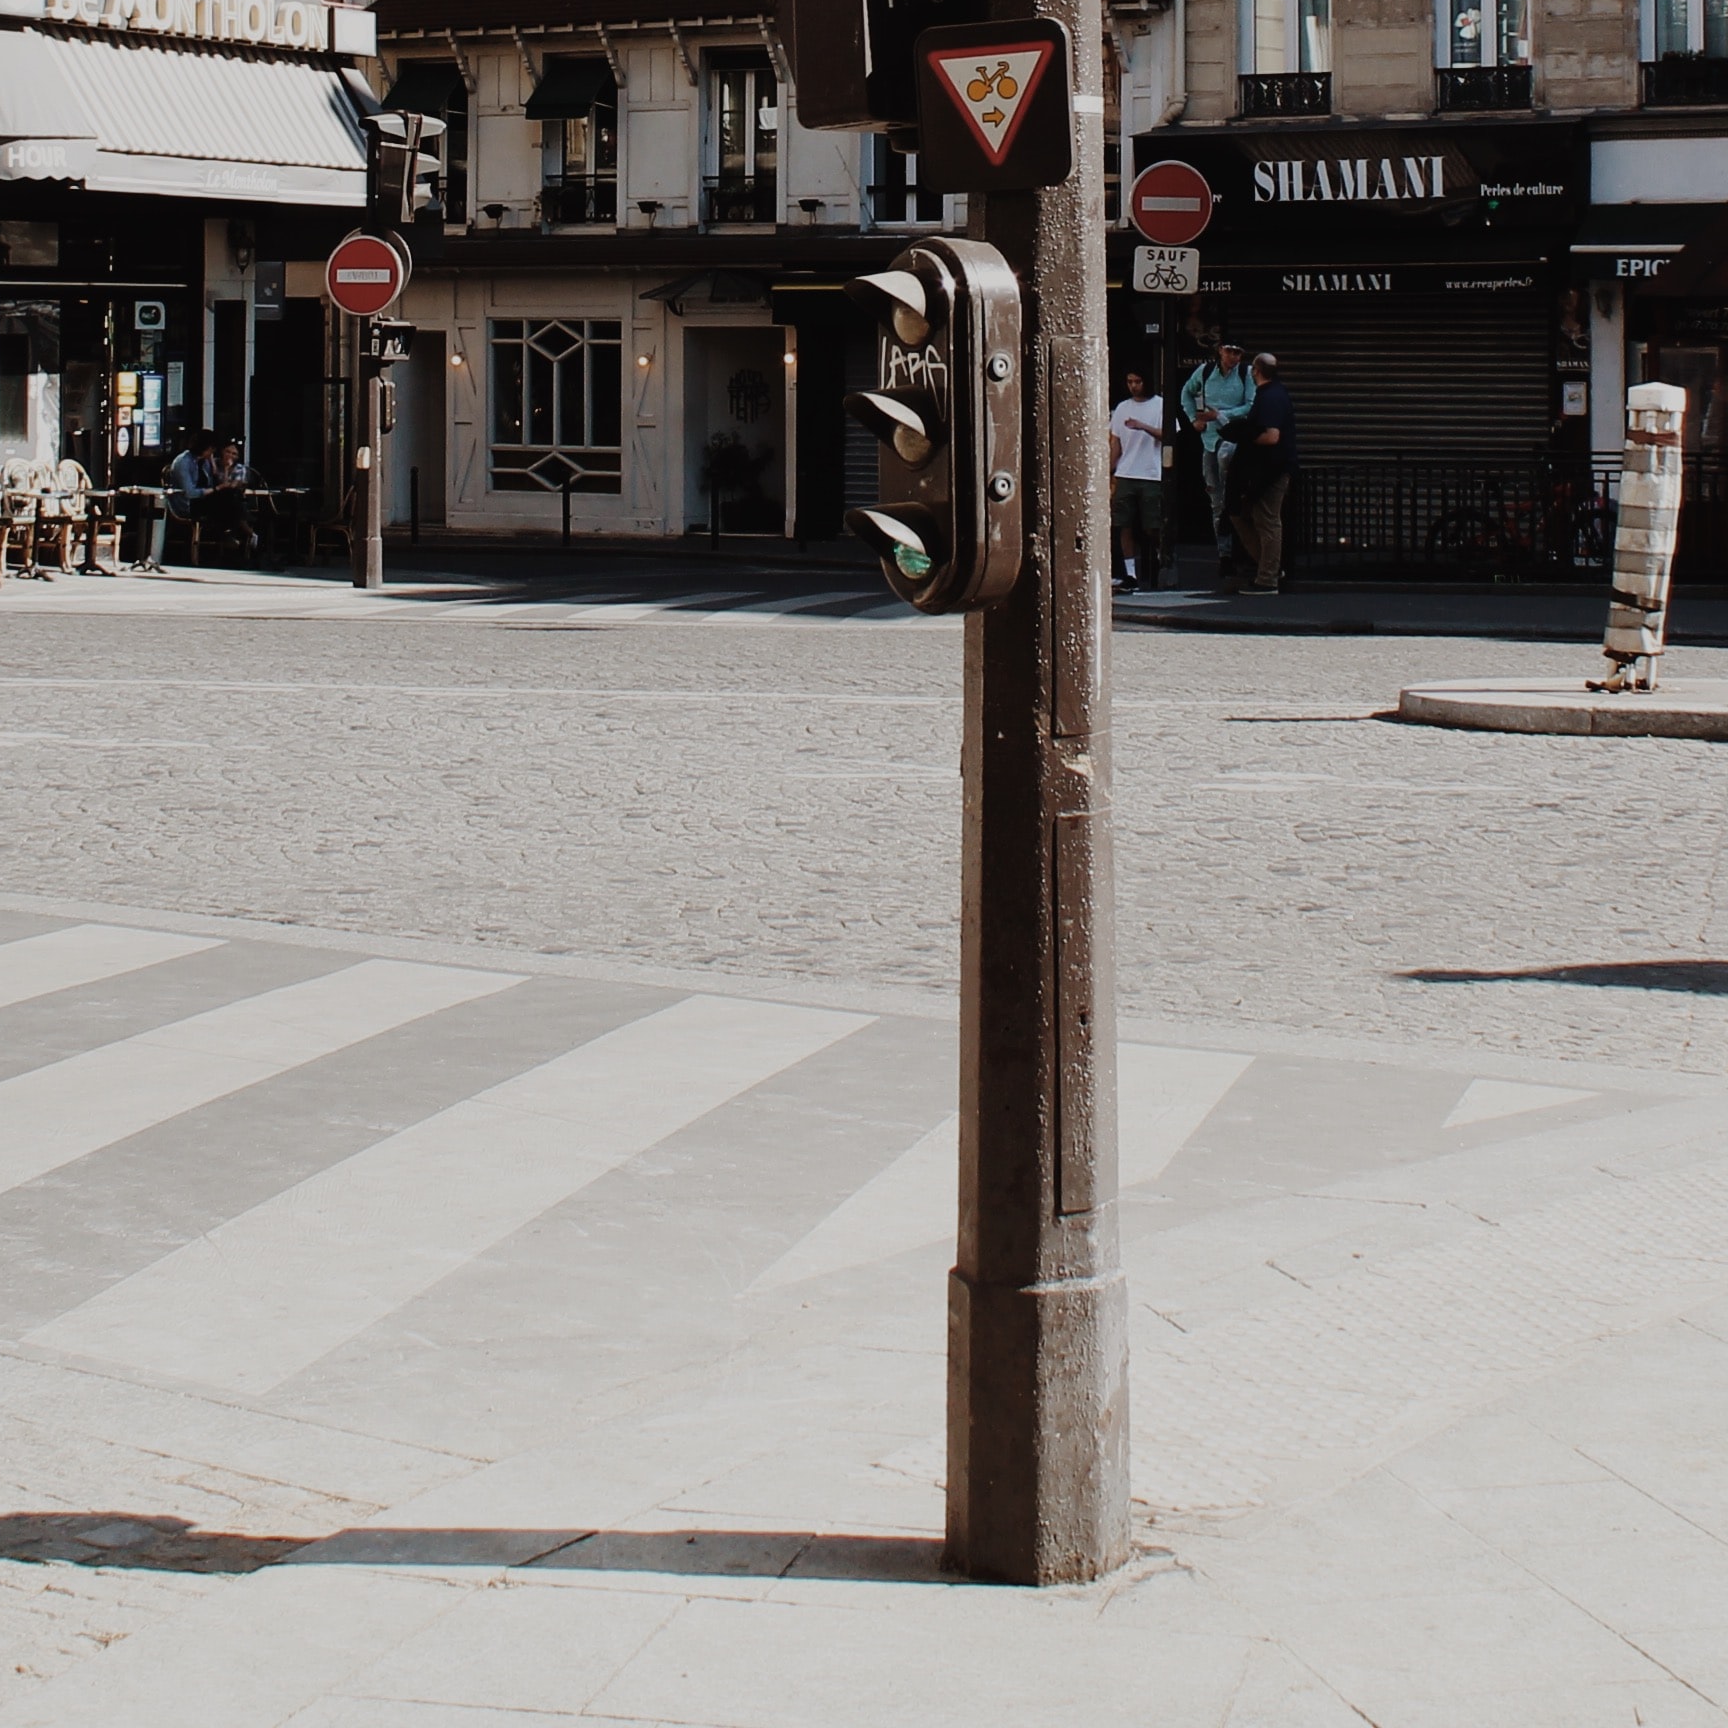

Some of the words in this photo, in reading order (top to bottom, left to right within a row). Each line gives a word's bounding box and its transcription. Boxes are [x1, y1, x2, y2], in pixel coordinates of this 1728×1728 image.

[8, 146, 68, 168] HOUR
[205, 171, 222, 189] Le
[223, 171, 277, 192] Montholon
[1254, 156, 1446, 202] SHAMANI
[1480, 183, 1511, 197] Perles
[1513, 184, 1525, 196] de
[1526, 182, 1564, 196] culture
[1146, 250, 1188, 263] SAUF
[1616, 258, 1670, 277] EPIC
[1282, 274, 1392, 291] SHAMANI
[1556, 360, 1590, 368] SHAMAN
